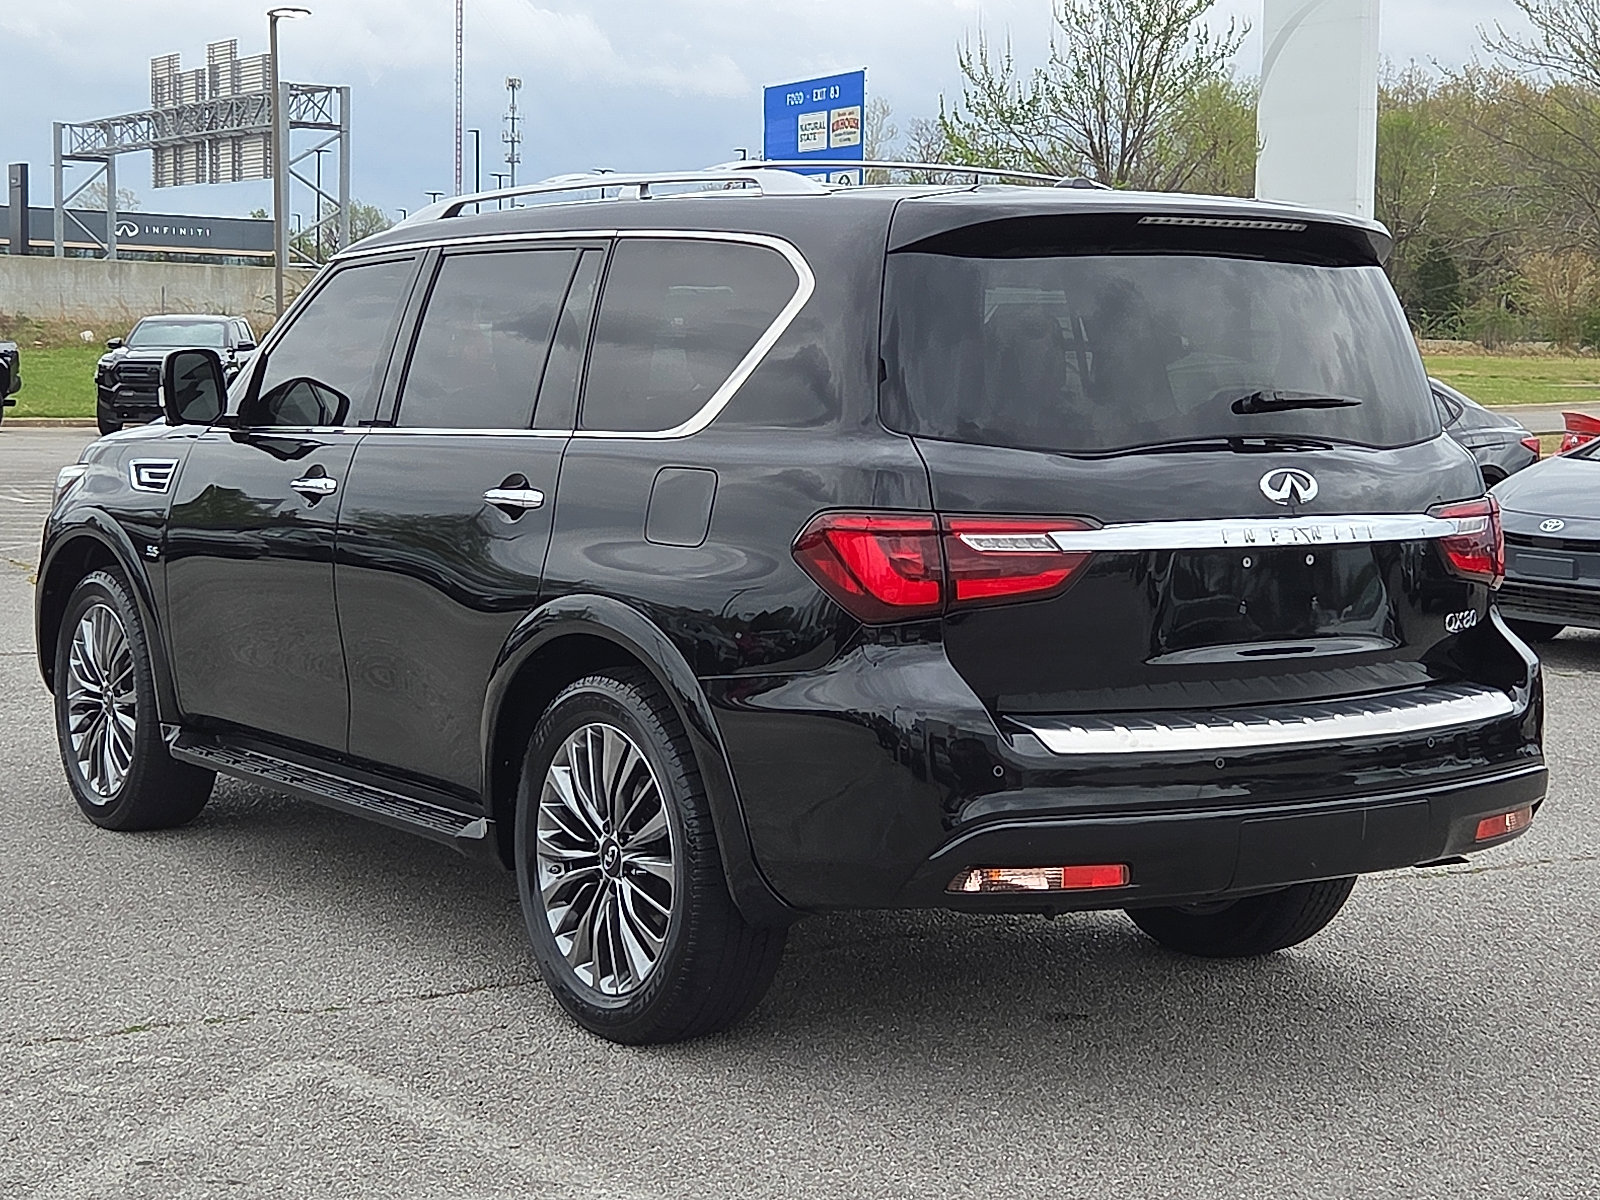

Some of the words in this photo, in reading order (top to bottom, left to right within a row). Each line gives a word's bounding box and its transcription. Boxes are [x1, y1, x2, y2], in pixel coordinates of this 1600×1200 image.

[786, 92, 804, 105] FOOD
[813, 88, 827, 101] EXIT
[799, 132, 817, 142] STATE
[145, 225, 211, 237] INFINITI
[1221, 524, 1374, 544] INFINITI
